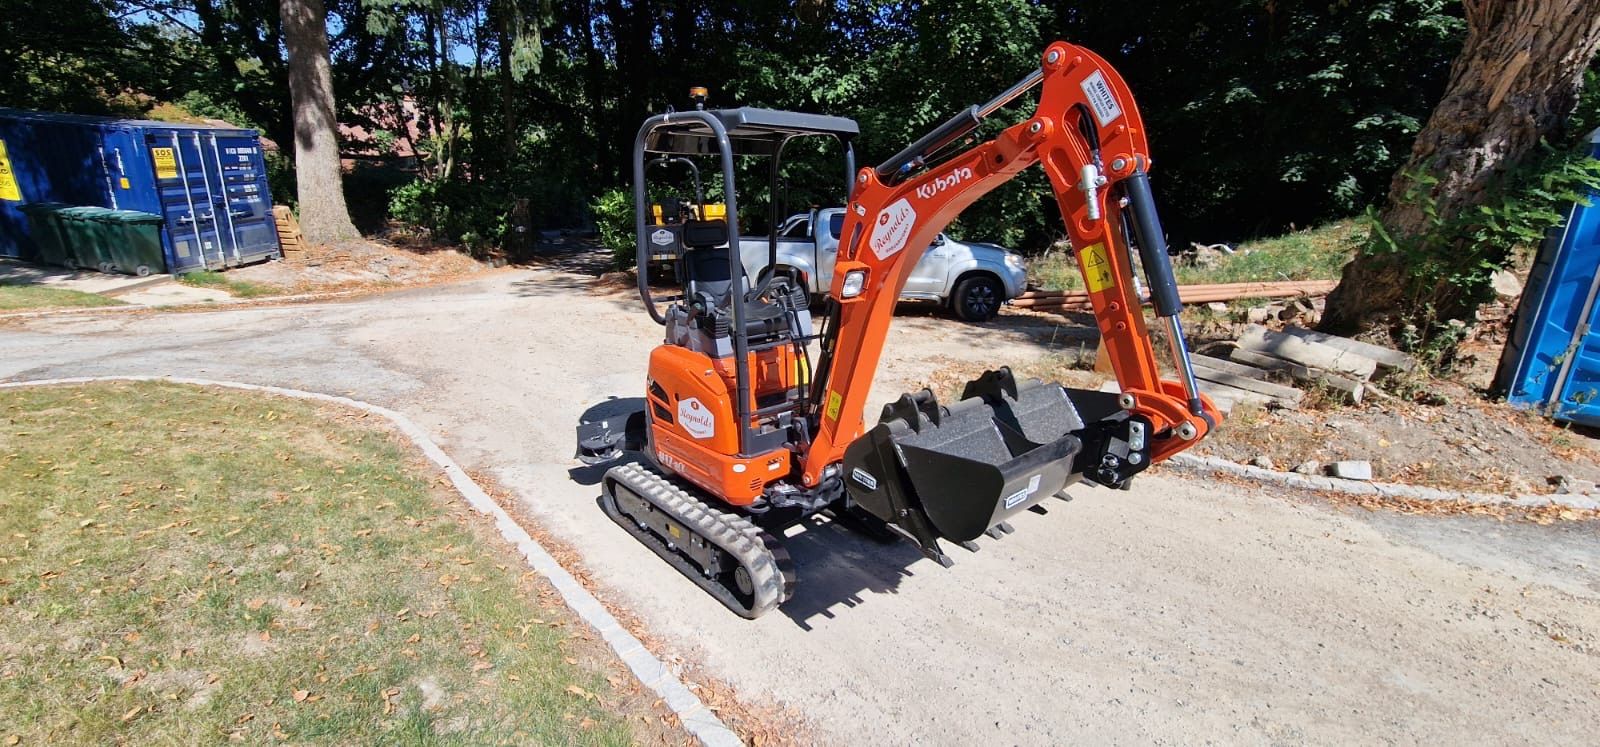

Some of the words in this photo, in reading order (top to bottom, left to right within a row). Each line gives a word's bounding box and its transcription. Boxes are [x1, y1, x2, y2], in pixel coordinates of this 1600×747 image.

[1096, 80, 1114, 110] WHITES
[916, 167, 972, 198] Kubota
[874, 208, 909, 253] Reynolds
[680, 406, 712, 427] Reynolds
